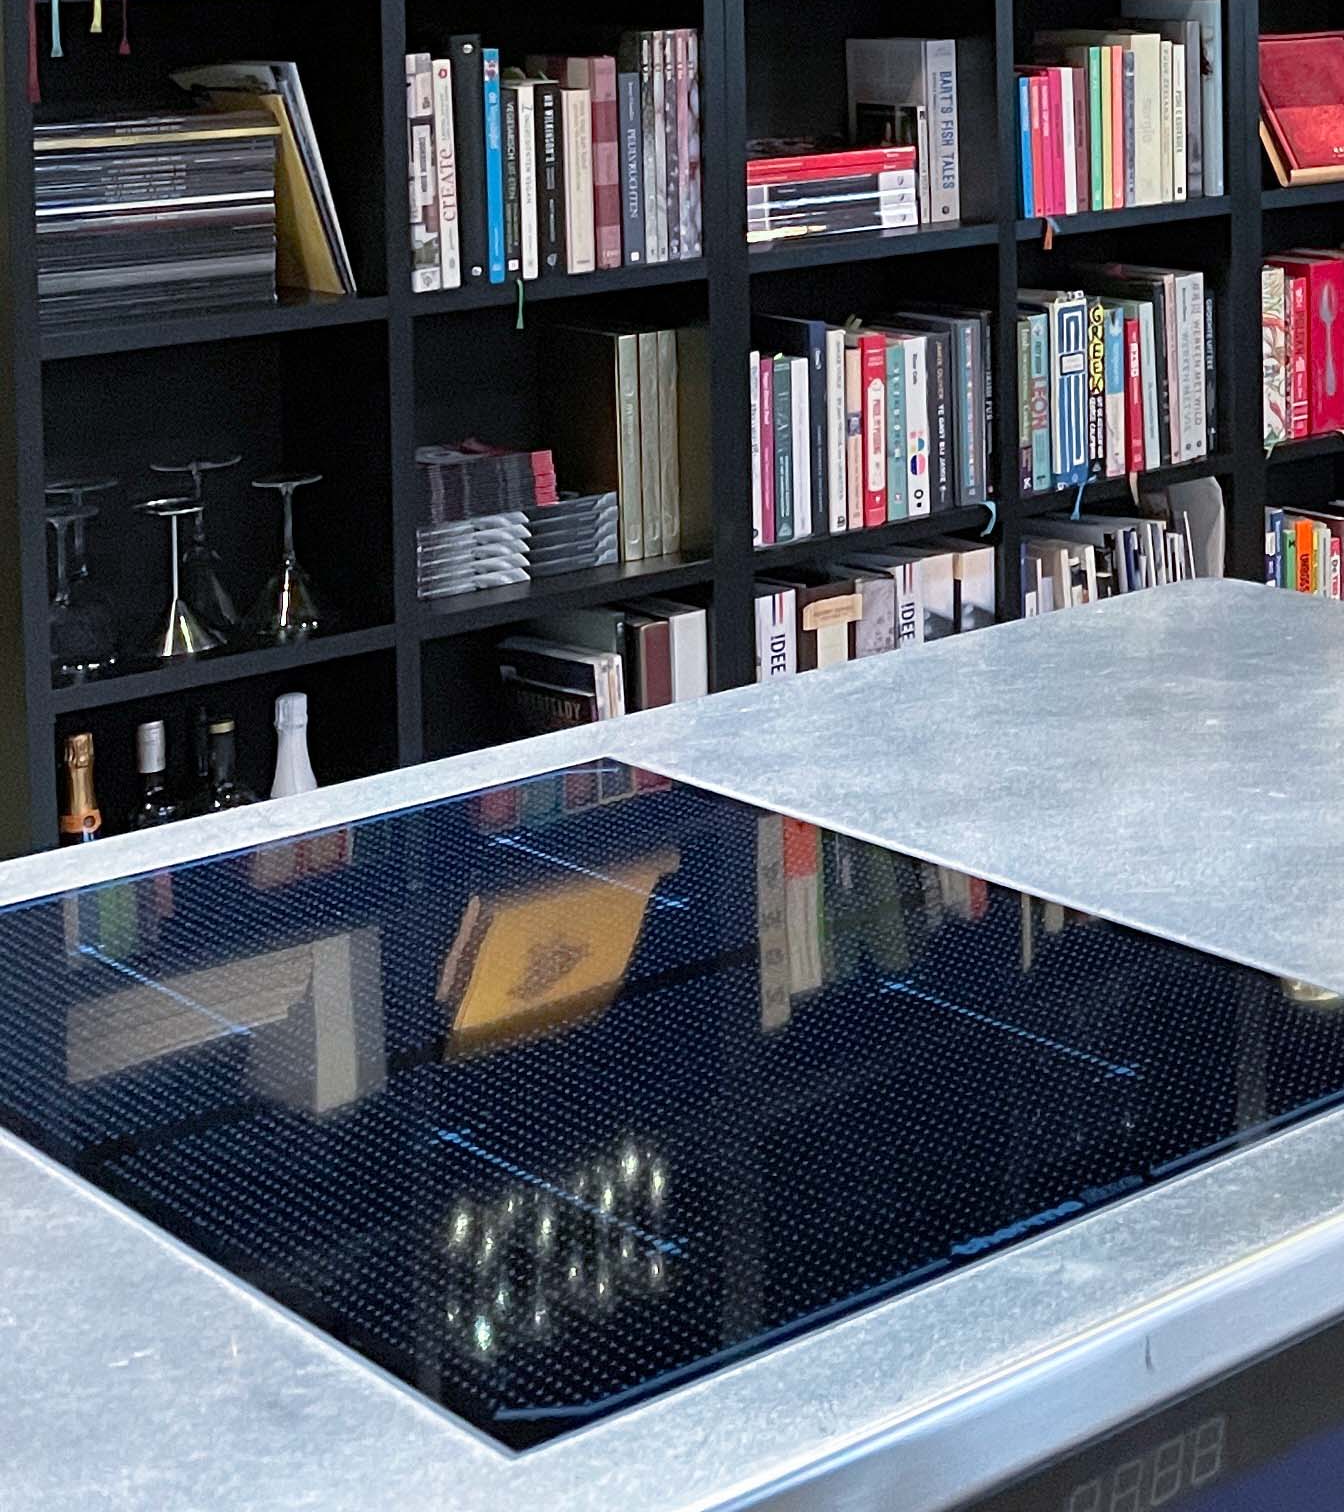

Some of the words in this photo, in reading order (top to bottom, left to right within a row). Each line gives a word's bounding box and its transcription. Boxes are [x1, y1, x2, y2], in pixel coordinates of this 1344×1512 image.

[939, 71, 954, 114] BART'S
[940, 120, 954, 147] FISH
[625, 128, 641, 219] PEULVRUCHTEN
[942, 154, 956, 190] TALES
[1089, 304, 1104, 395] GREEK
[1193, 319, 1202, 368] WERKEN
[1031, 375, 1049, 430] LEON
[1194, 372, 1203, 393] MET
[937, 403, 945, 416] TE
[1194, 396, 1203, 426] WILD
[770, 634, 787, 676] !DEE
